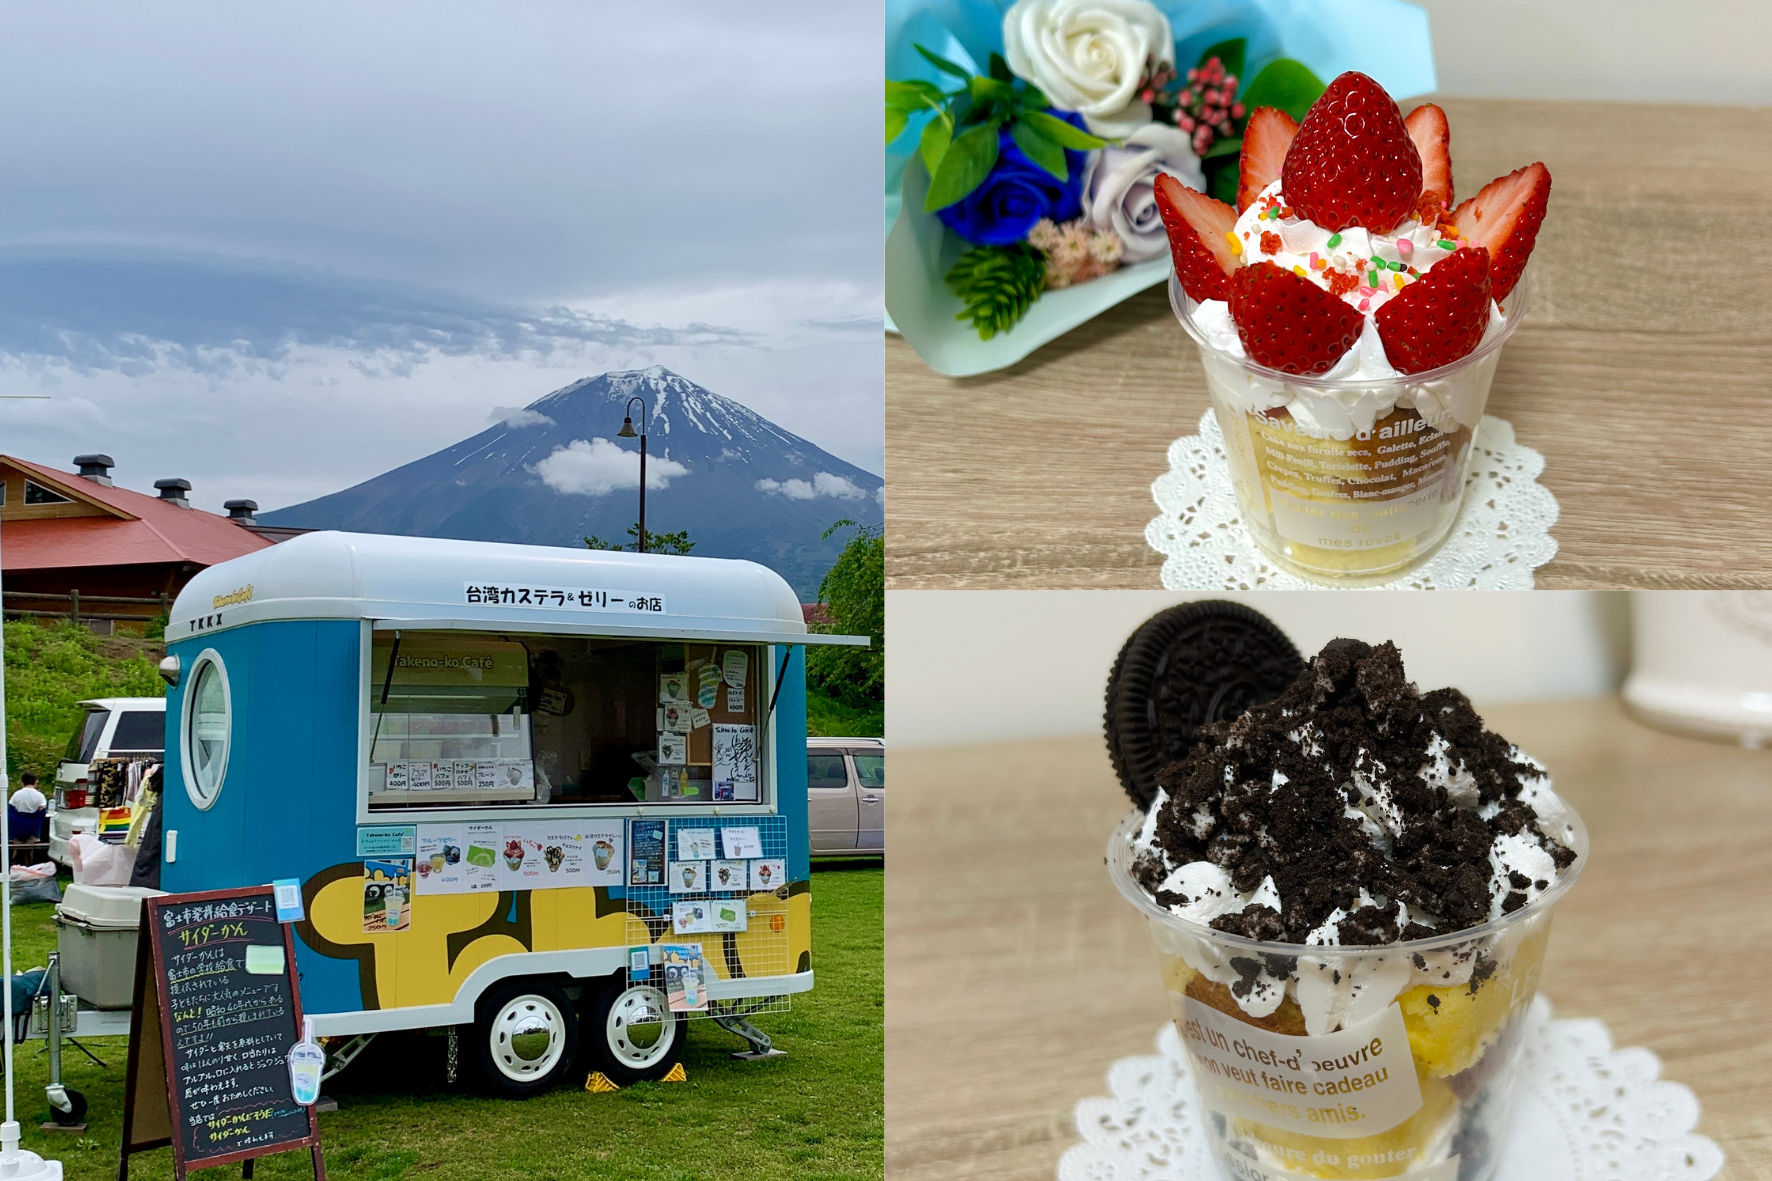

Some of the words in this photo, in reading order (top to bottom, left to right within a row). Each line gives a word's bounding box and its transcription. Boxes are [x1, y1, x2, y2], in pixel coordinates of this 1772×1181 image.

[1262, 431, 1285, 446] Cake
[1374, 454, 1418, 469] Pudding,
[1347, 472, 1397, 485] Chocolat,
[1350, 524, 1371, 534] de
[1319, 536, 1353, 547] mes
[1359, 531, 1402, 547] reves
[462, 654, 494, 669] Café
[178, 922, 249, 946] サイダーかん
[171, 948, 225, 966] サイダーかんは
[168, 958, 245, 981] 富士市の学校給食で
[170, 976, 230, 995] 提供されている
[185, 1033, 283, 1059] サイダーと寒天を原料としていて
[1205, 1027, 1231, 1052] un
[1221, 1062, 1260, 1086] veut
[1261, 1071, 1308, 1095] faire
[1312, 1066, 1390, 1096] cadeau
[1245, 1091, 1301, 1120] chers
[1306, 1102, 1367, 1124] amis.
[188, 1113, 215, 1126] 当店では
[209, 1126, 251, 1142] サイダーかん
[1312, 1148, 1340, 1166] du
[1347, 1145, 1417, 1169] gouter
